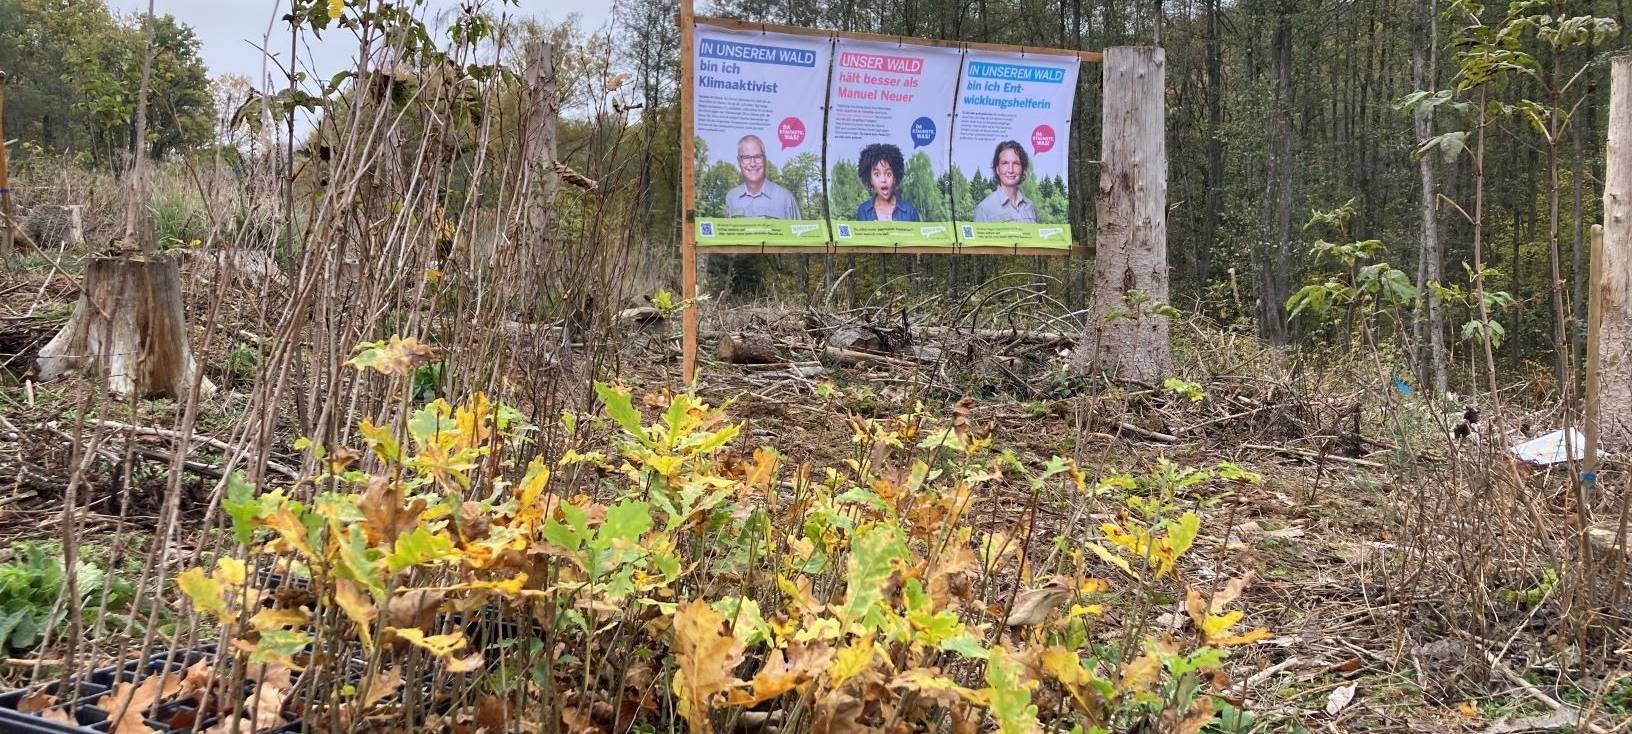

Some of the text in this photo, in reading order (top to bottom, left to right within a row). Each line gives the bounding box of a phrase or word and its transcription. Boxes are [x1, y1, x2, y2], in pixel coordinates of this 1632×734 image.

[701, 42, 814, 64] IN UNSEREM WALD
[700, 60, 740, 74] bin ich
[842, 54, 921, 72] UNSER WALD
[840, 71, 919, 88] hält besser als
[969, 64, 1063, 81] IN UNSEREM WALD
[699, 75, 778, 93] Klimaaktivist
[967, 81, 1024, 94] bin ich Ent-
[838, 87, 913, 102] Manuel Neuer
[964, 95, 1050, 109] wicklungshelferin
